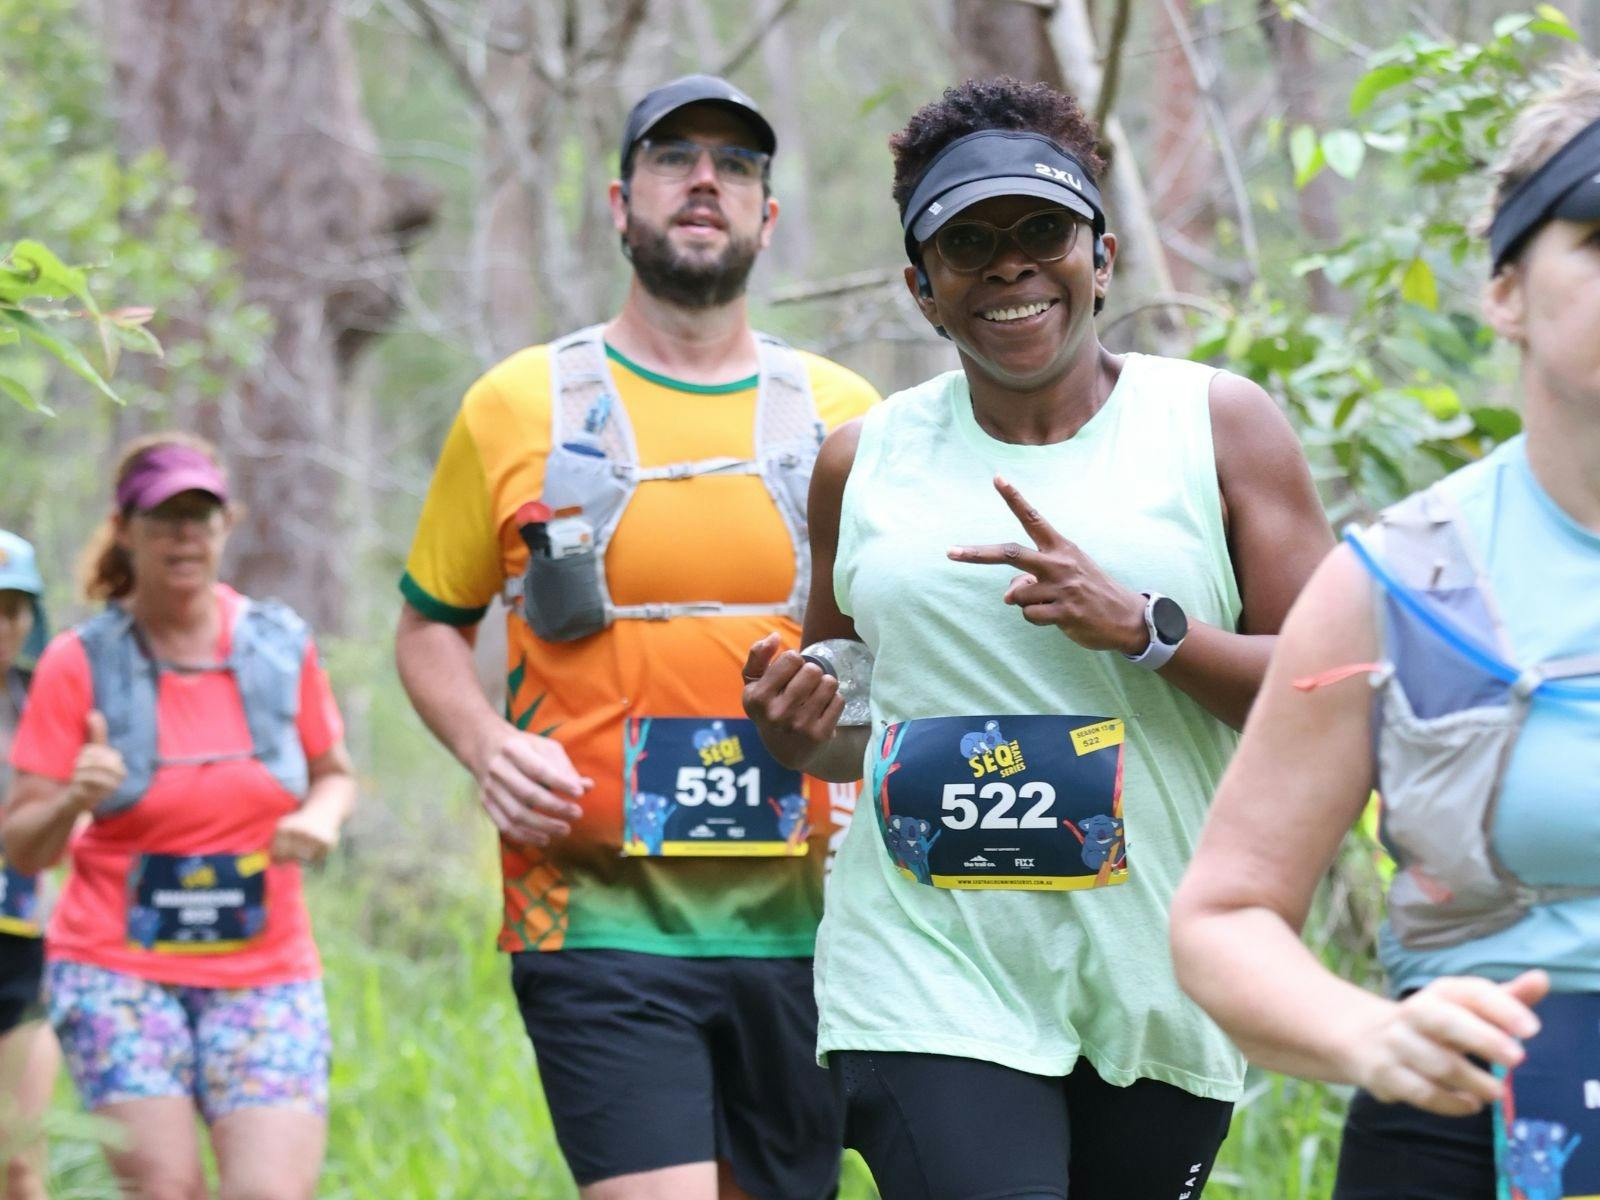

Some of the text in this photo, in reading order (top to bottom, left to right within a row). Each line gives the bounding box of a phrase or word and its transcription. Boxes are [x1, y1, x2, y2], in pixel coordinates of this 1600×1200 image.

[1035, 163, 1082, 190] 2XU
[1076, 727, 1100, 739] SEASON
[1082, 736, 1100, 747] 522
[969, 745, 1014, 778] SEQ
[1009, 739, 1024, 764] TRAIL
[1000, 761, 1026, 778] SERIES
[675, 766, 761, 807] 531
[941, 781, 1058, 830] 522
[1014, 858, 1036, 867] FIXX
